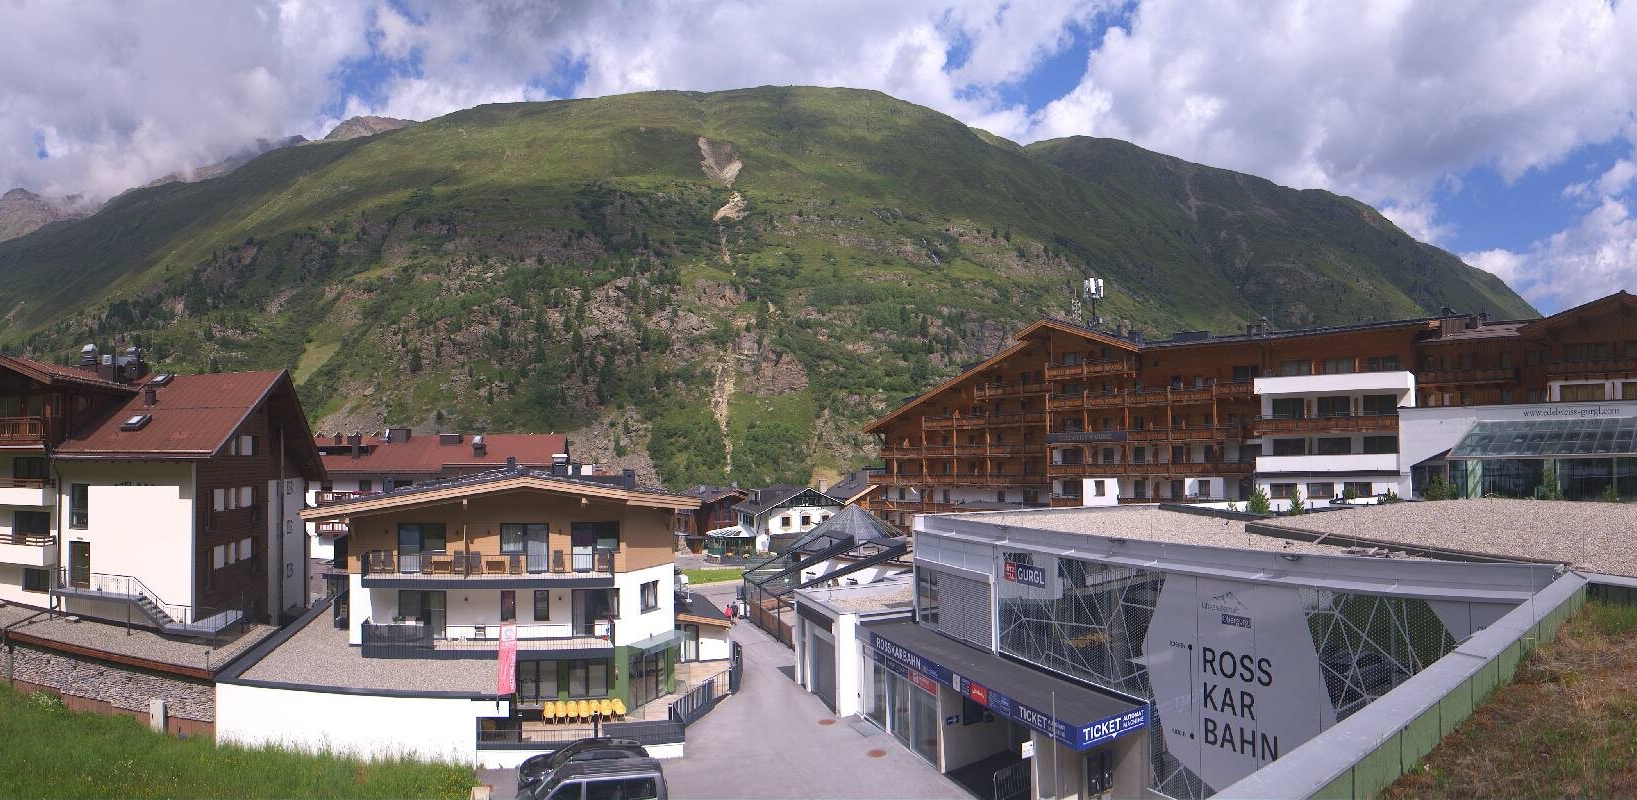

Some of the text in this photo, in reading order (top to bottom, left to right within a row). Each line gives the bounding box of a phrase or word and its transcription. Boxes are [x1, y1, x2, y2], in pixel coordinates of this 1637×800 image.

[1524, 405, 1620, 418] www.edelweiss-gurgl.com
[1017, 567, 1045, 585] GURGL
[876, 637, 921, 670] ROSSKARBAHN
[1202, 646, 1273, 687] ROSS
[1203, 682, 1255, 721] KAR
[1018, 705, 1048, 729] TICKET
[1082, 717, 1122, 741] TICKET
[1204, 717, 1278, 762] BAHN
